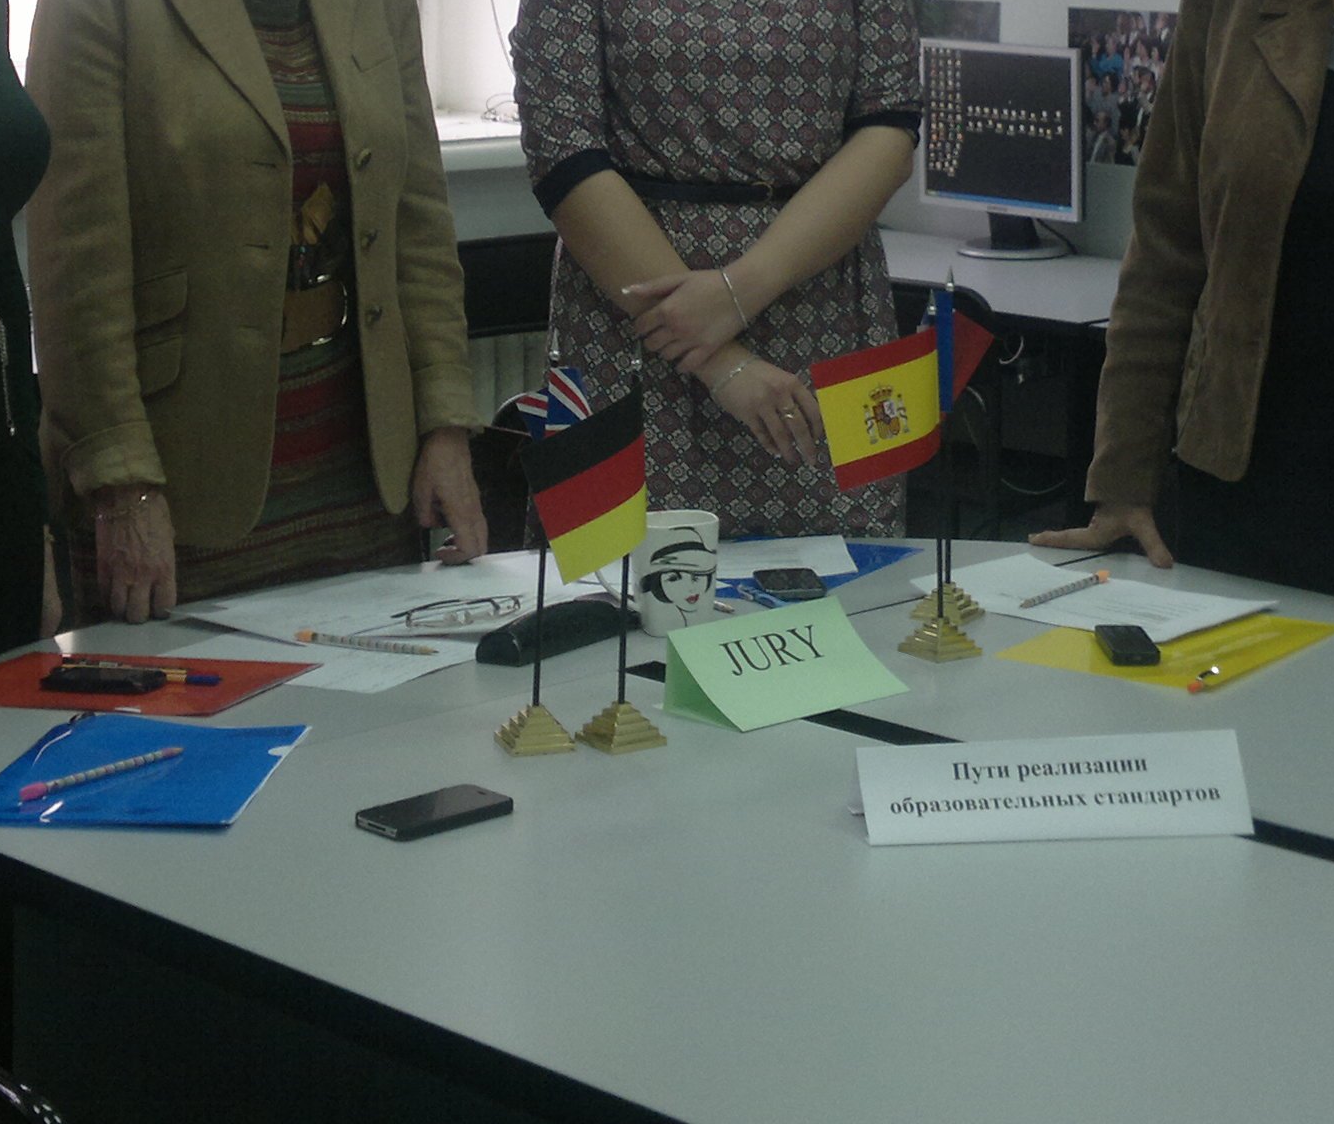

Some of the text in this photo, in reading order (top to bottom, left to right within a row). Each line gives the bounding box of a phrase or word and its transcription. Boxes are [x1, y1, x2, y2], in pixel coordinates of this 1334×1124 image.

[718, 624, 825, 677] JURY
[952, 756, 1148, 785] Пути реализации
[890, 785, 1222, 818] образовательных стандартов
